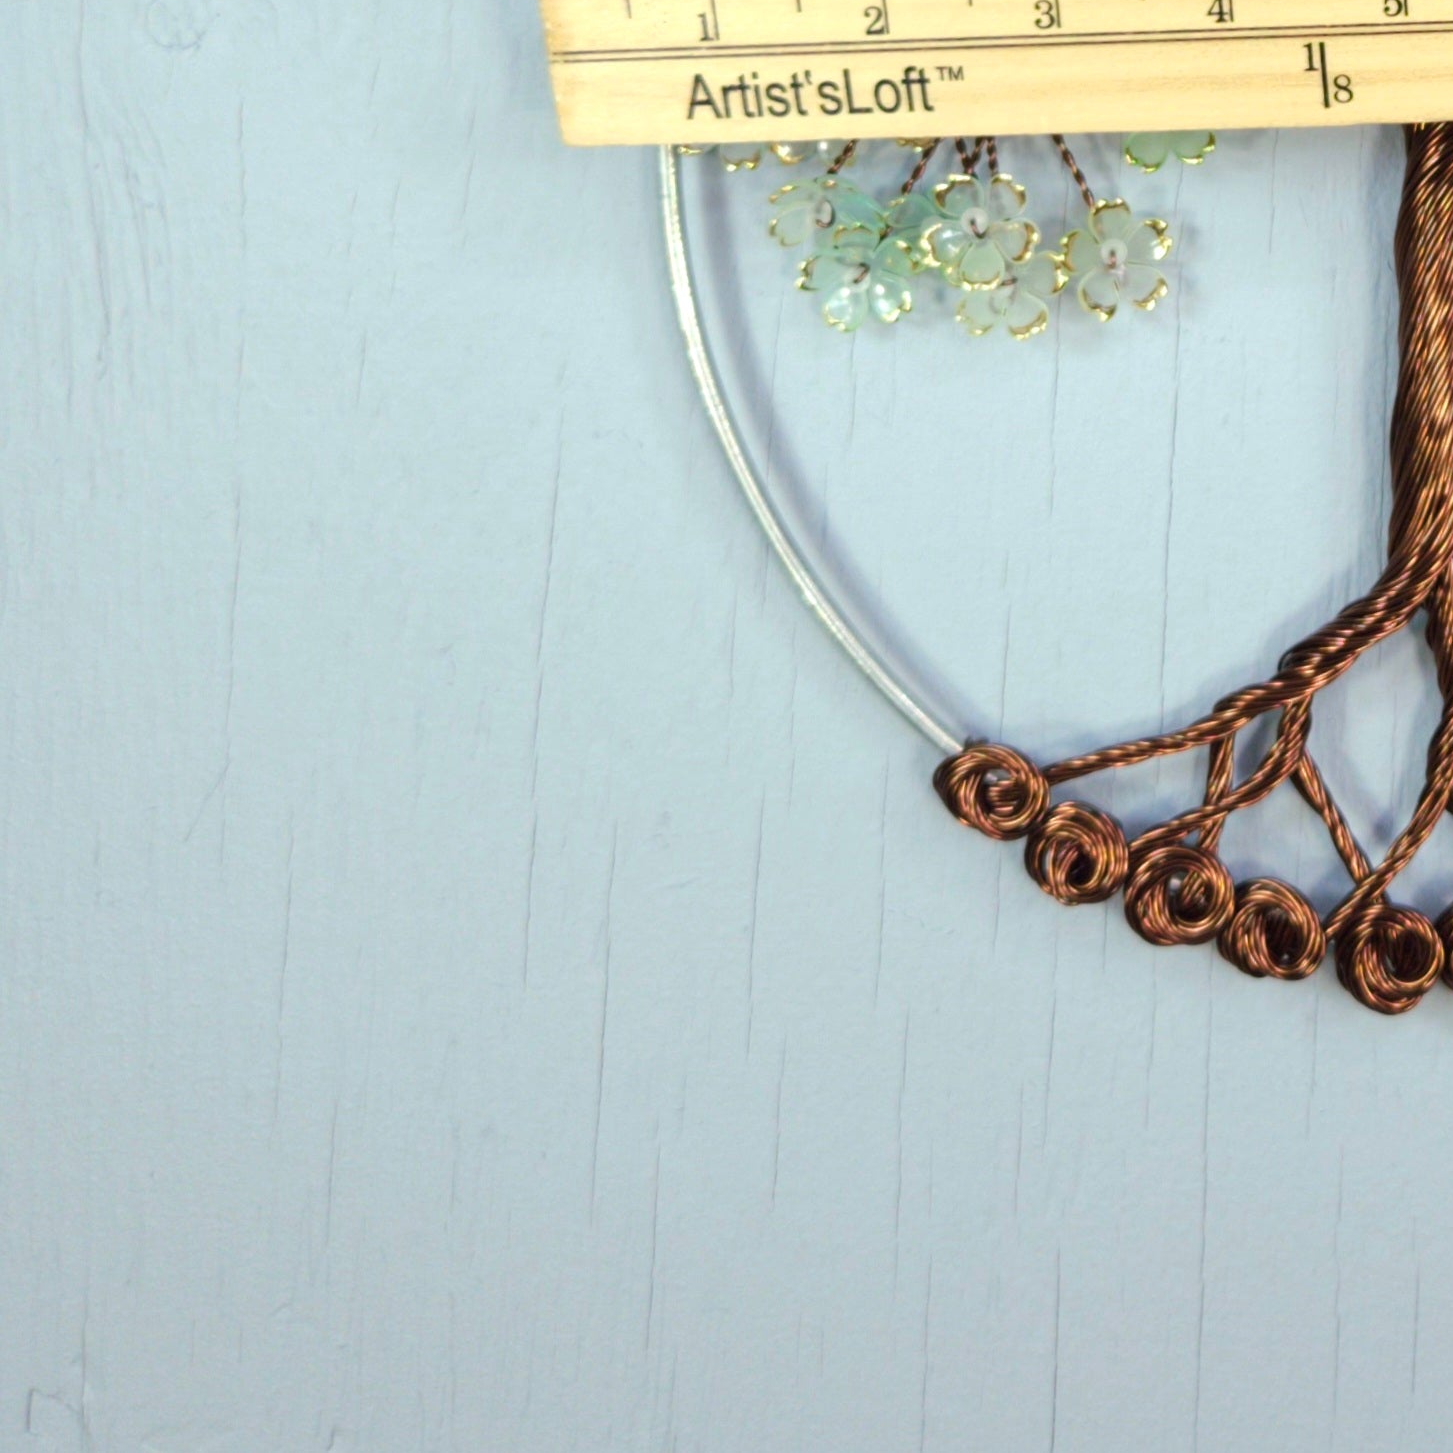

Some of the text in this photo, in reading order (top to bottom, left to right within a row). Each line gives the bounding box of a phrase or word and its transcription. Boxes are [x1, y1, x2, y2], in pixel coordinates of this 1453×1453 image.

[697, 12, 713, 41] 1
[864, 7, 885, 35] 2
[1034, 0, 1055, 29] 3
